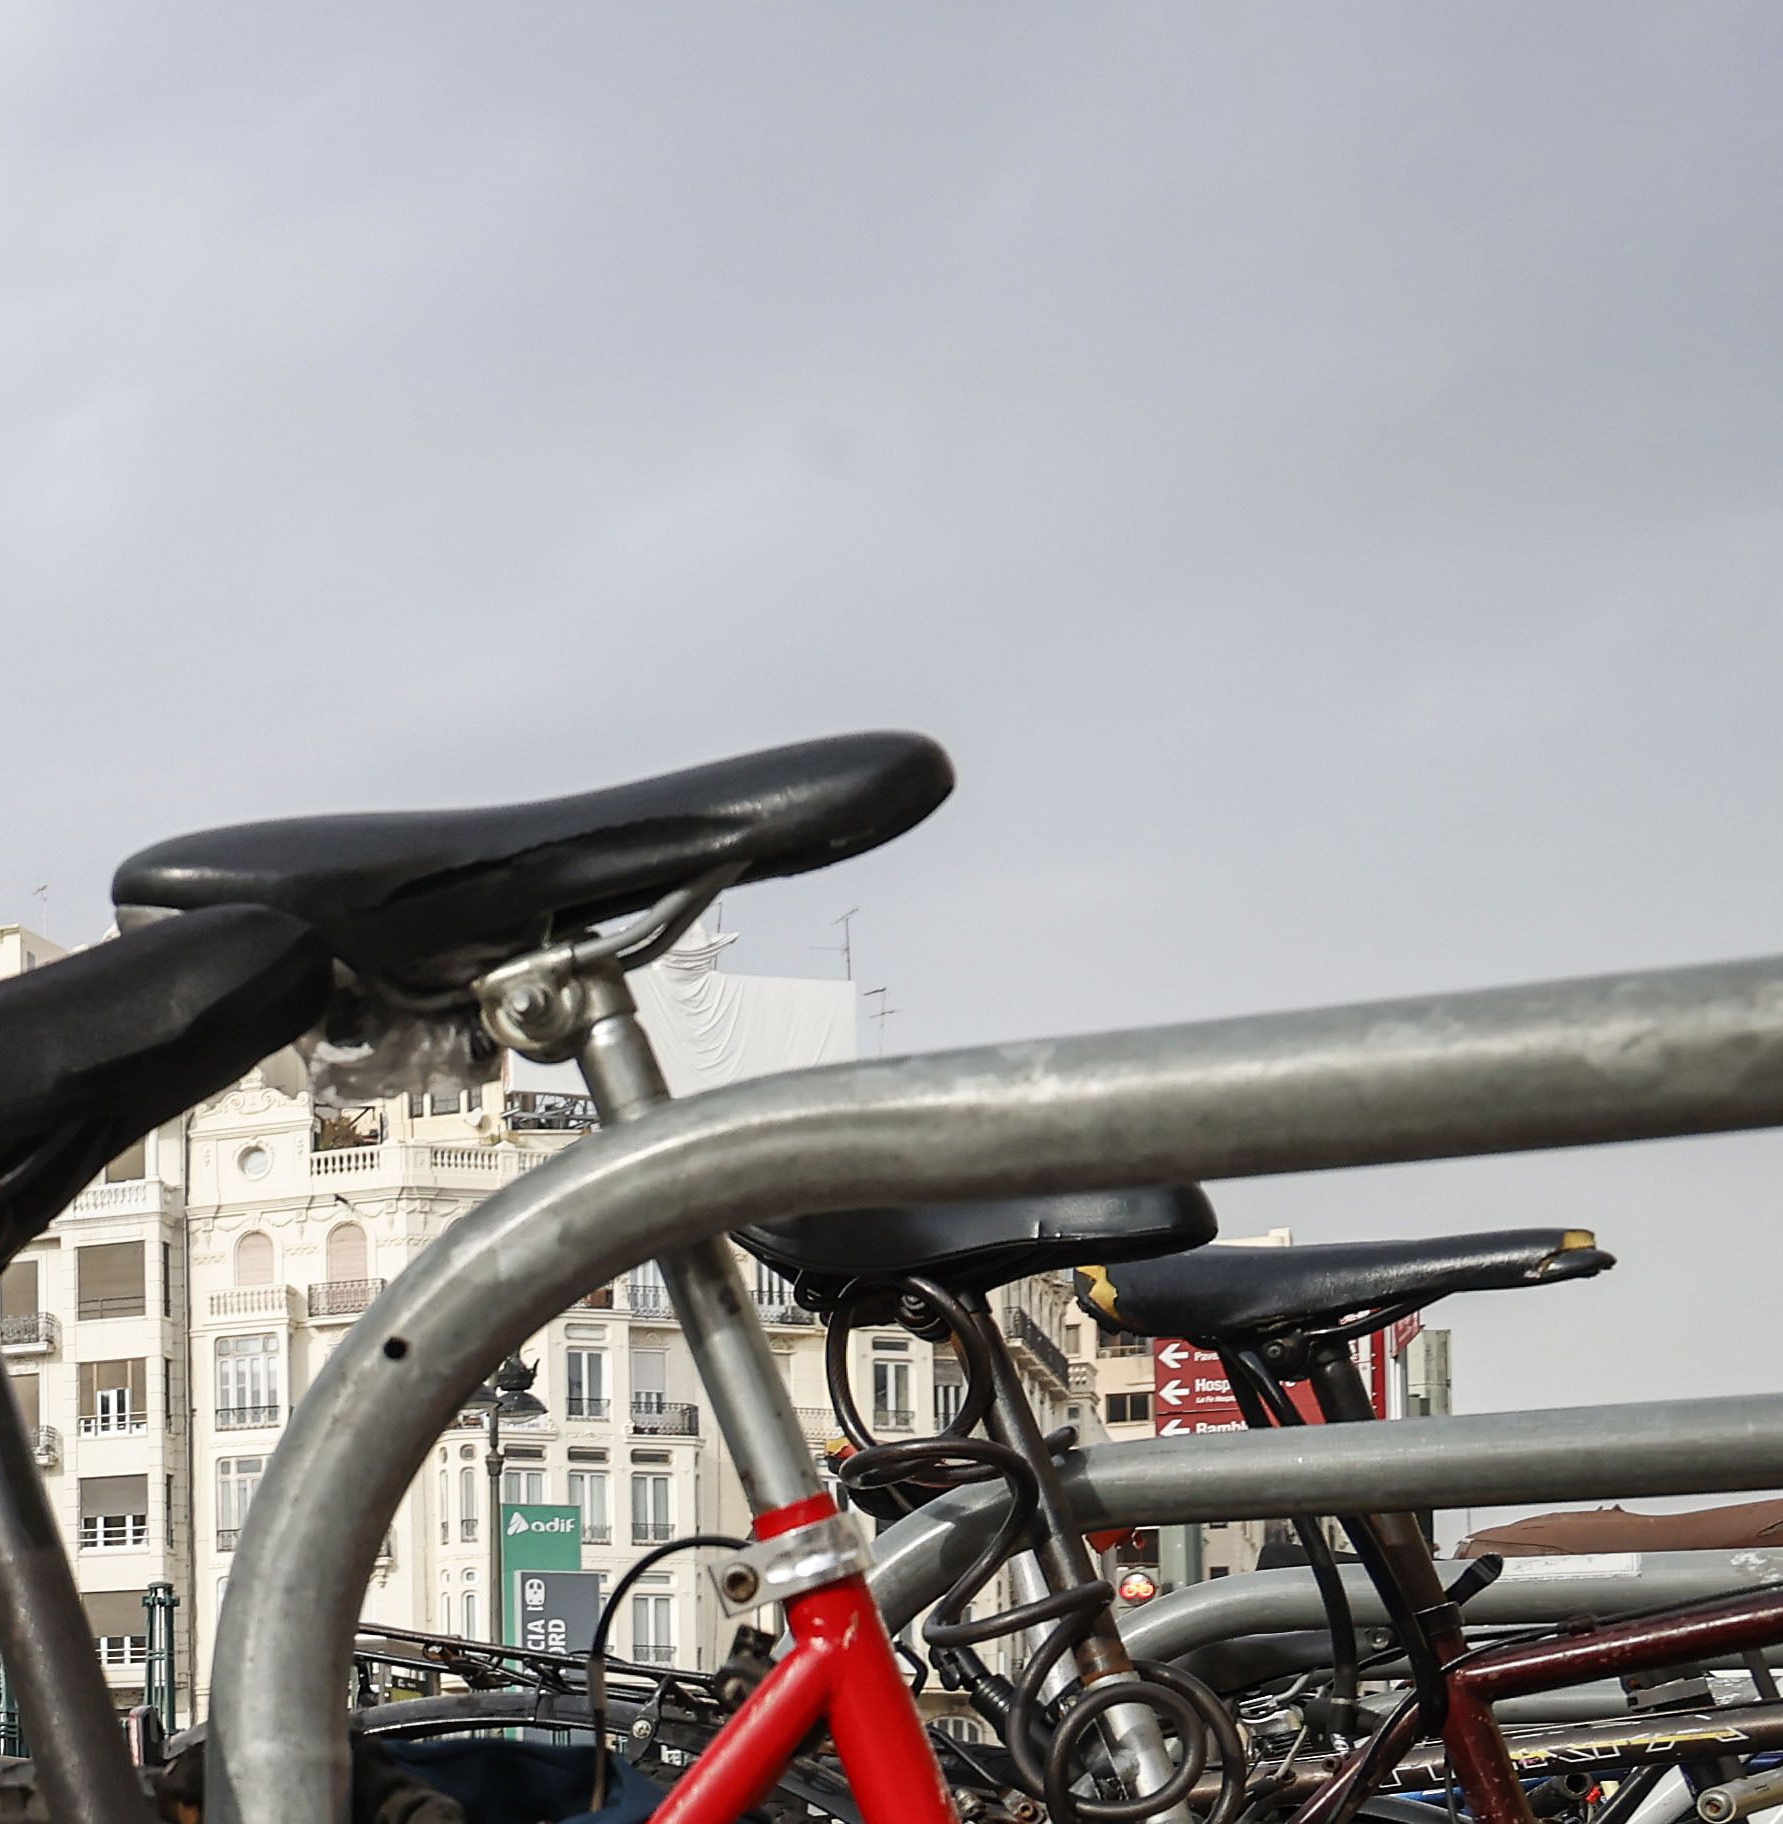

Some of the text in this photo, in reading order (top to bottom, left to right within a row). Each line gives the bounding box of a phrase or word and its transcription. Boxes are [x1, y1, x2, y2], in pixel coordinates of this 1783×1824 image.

[1195, 1378, 1232, 1394] Hosp
[531, 1517, 576, 1533] adif
[526, 1619, 546, 1651] CIA
